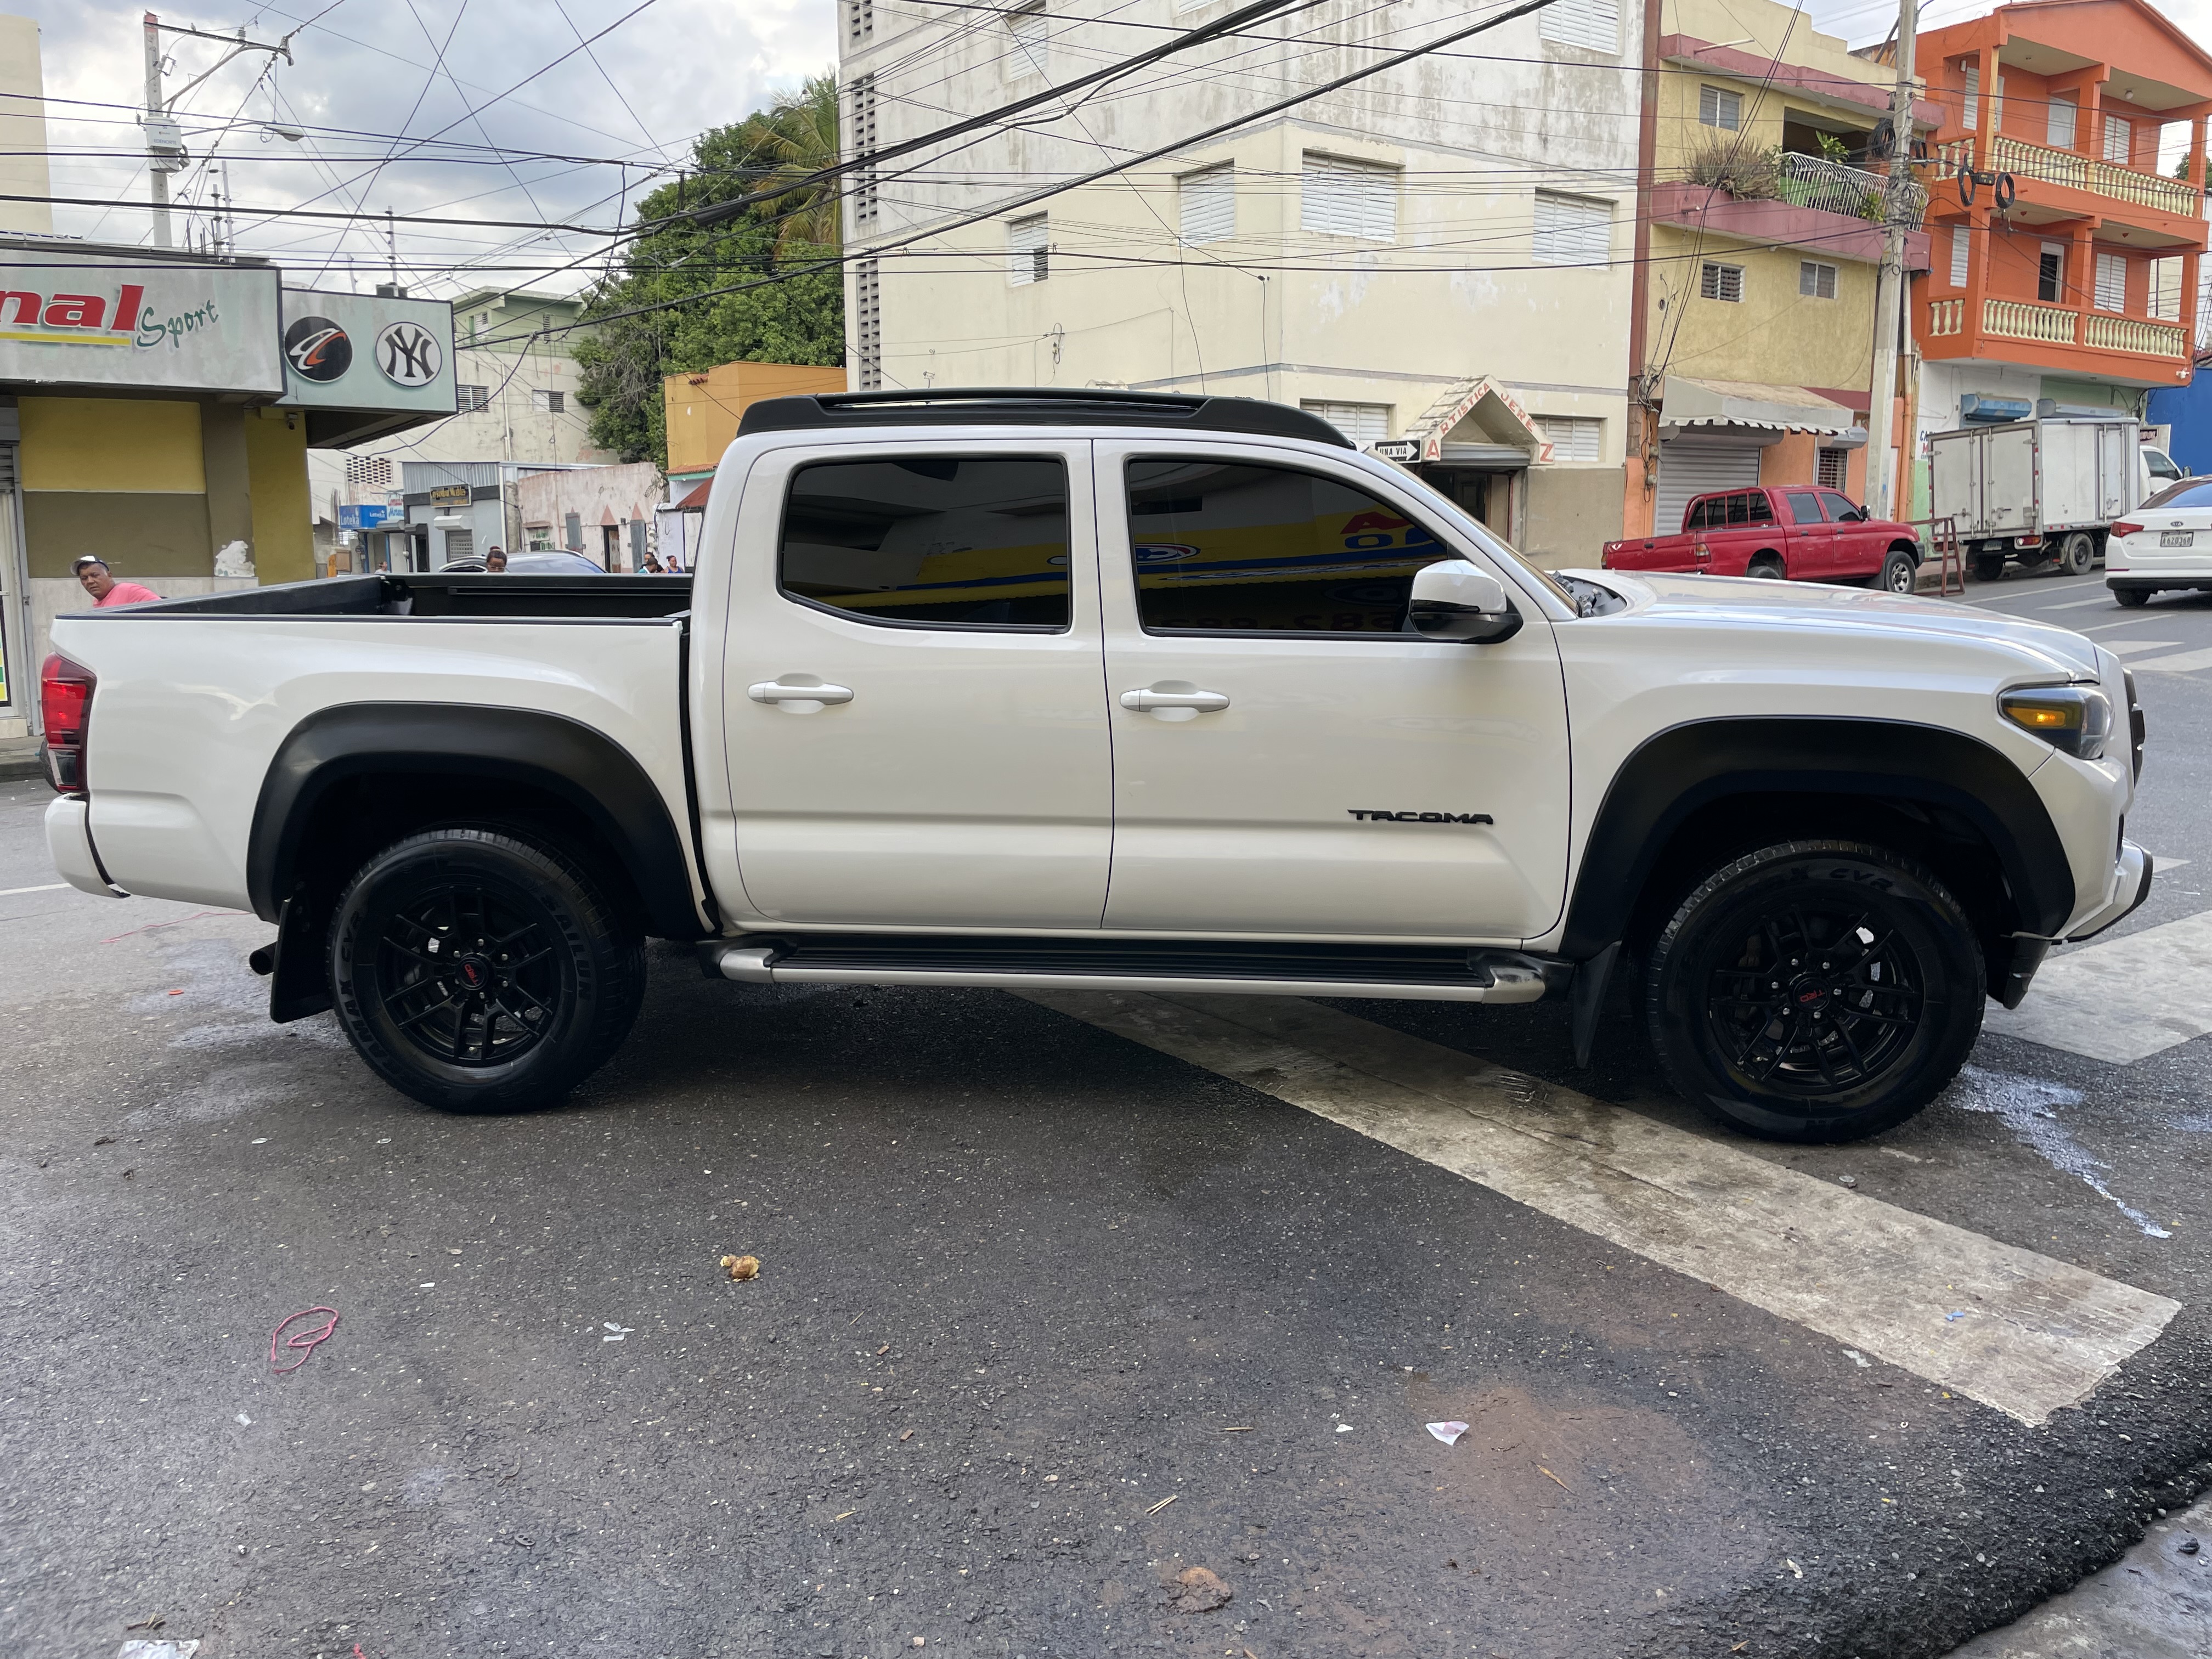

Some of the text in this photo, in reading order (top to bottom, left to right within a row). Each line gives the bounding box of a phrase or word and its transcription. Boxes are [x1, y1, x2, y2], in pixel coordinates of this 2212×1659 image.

[137, 300, 219, 348] Sport
[1425, 382, 1554, 462] ARTISTICA JEREZ
[1347, 809, 1493, 825] TACOMA
[1800, 989, 1825, 1002] TRD
